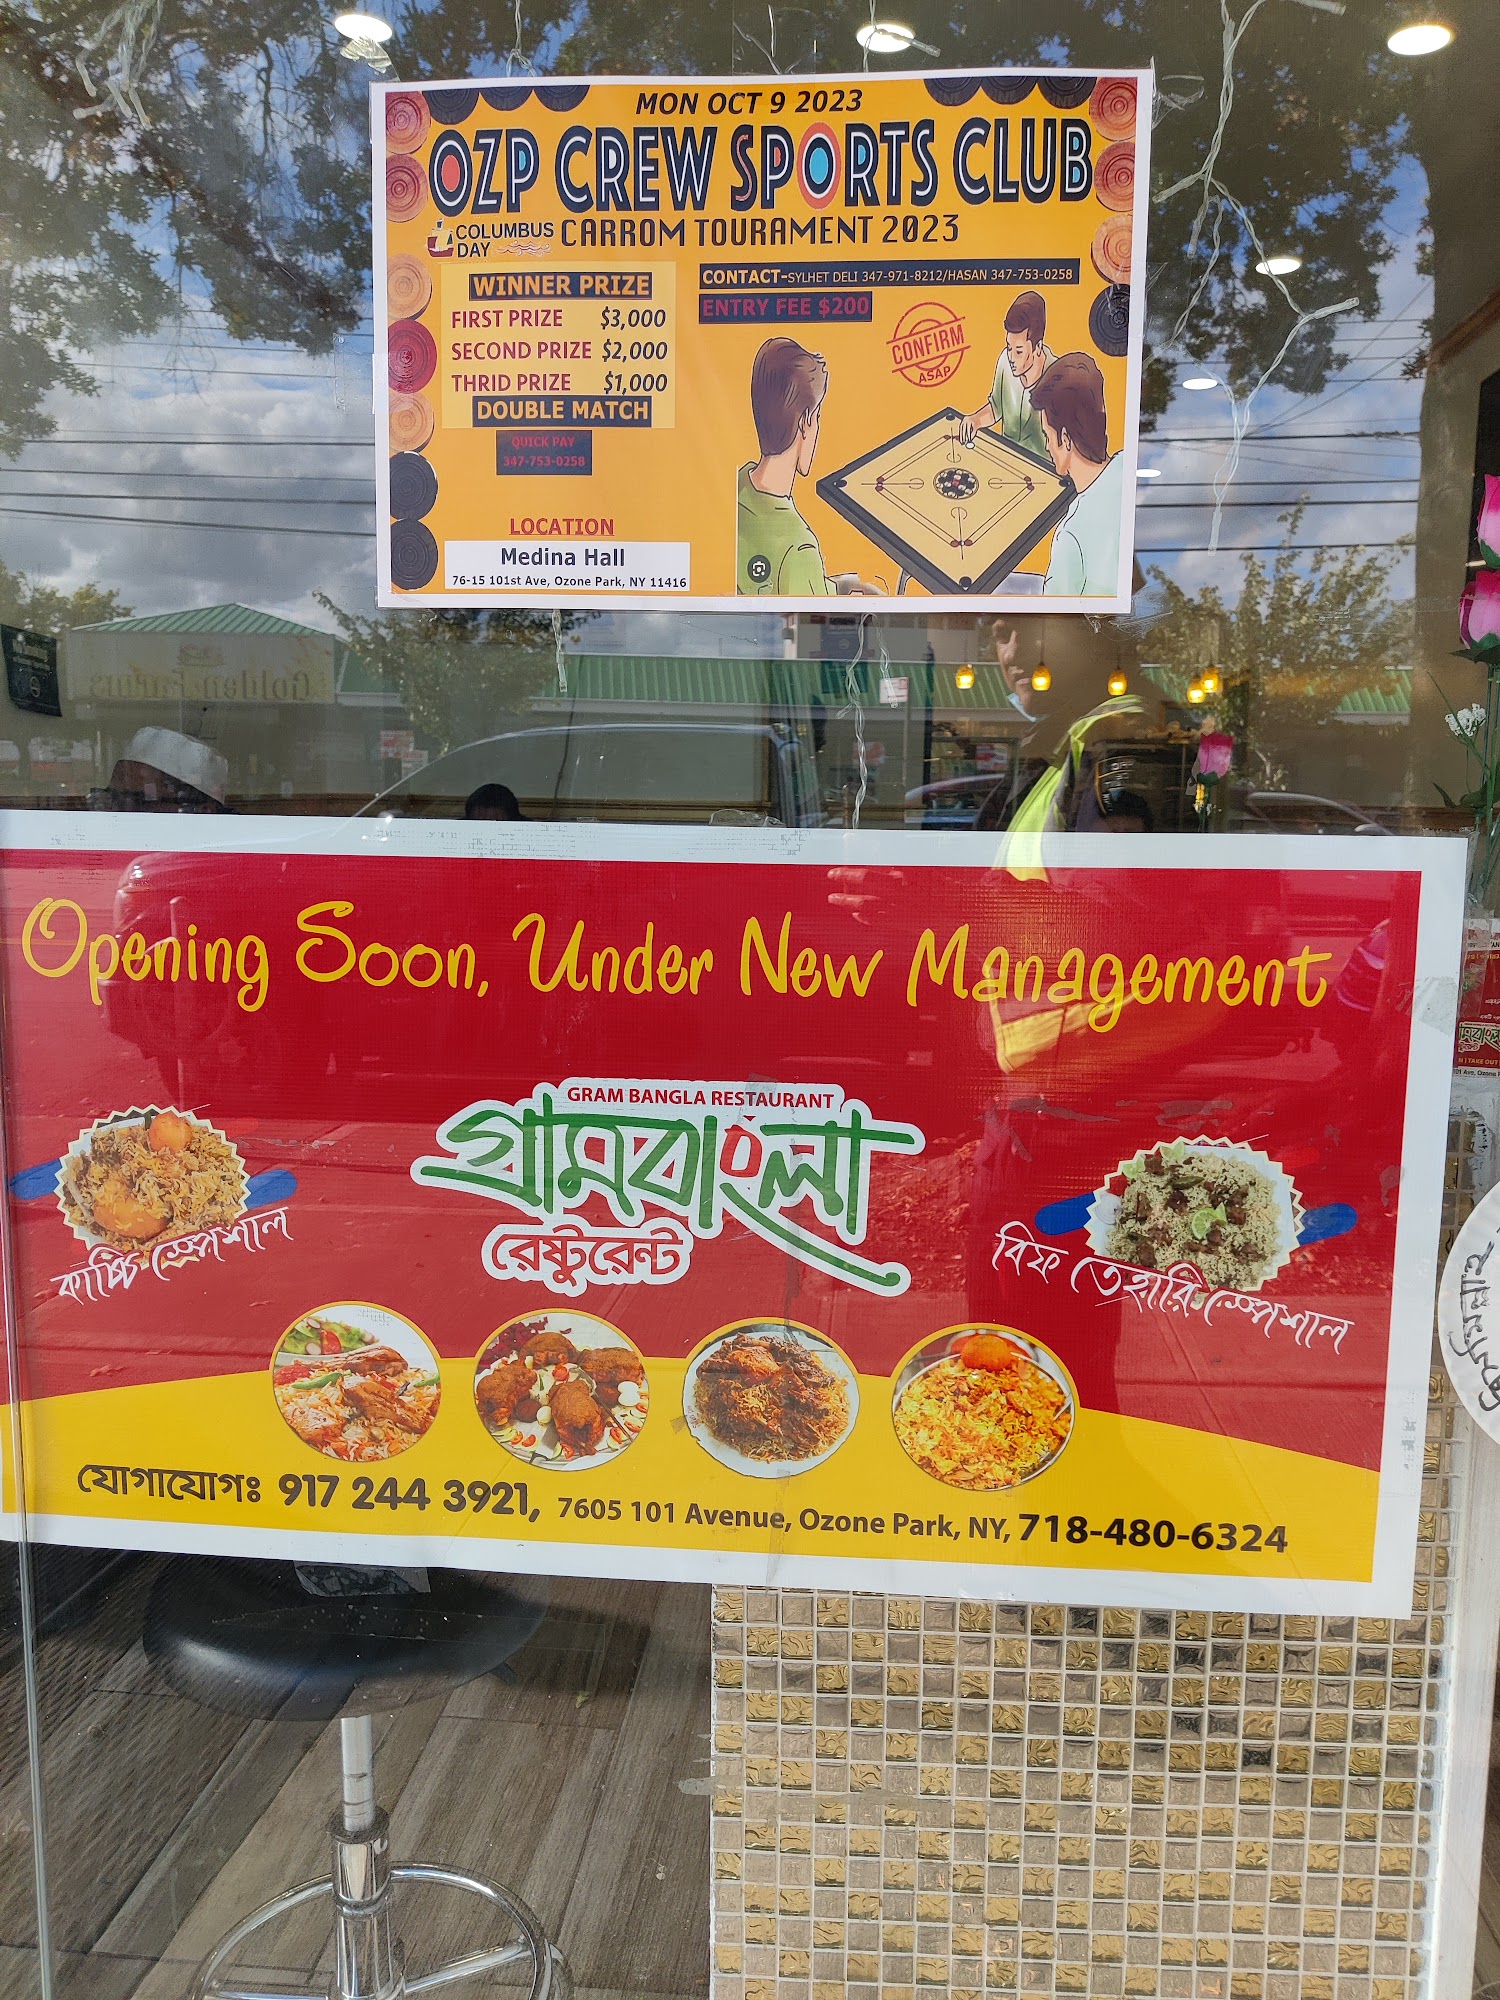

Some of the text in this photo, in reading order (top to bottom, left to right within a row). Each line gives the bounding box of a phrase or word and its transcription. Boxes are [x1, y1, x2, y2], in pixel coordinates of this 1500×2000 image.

[636, 89, 863, 115] MON OCT 9 2023
[428, 117, 1093, 217] OZP CREW SPORTS CLUB
[456, 222, 554, 240] COLUMBUS
[561, 214, 959, 247] CARROM TOURAMENT 2023
[457, 241, 490, 258] DAY
[473, 273, 650, 297] WINNER PRIZE
[833, 271, 858, 284] DELI
[861, 269, 987, 283] 347-971-8212/HASAN
[991, 268, 1073, 281] 347-753-0258
[451, 306, 667, 330] FIRST PRIZE $3,000
[703, 295, 869, 317] ENTRY FEE $200
[451, 338, 668, 363] SECOND PRIZE $2,000
[892, 324, 964, 364] CONFIRM
[451, 371, 668, 395] THRID PRIZE $1,000
[918, 366, 951, 383] ASAP
[477, 400, 649, 420] DOUBLE MATCH
[512, 436, 575, 449] QUICK PAY
[503, 455, 586, 468] 347-753-0258
[509, 518, 615, 537] LOCATION
[501, 547, 625, 567] Medina Hall
[452, 575, 686, 589] 76-15 101st Ave, Ozone Park, NY 11416
[22, 897, 1332, 1032] Opening Soon, Under New Management
[567, 1087, 835, 1109] GRAM BANGLA RESTAURANT
[420, 1093, 916, 1287] গ্রামবাংলা
[992, 1220, 1069, 1284] বিফ
[278, 1473, 340, 1507] 917
[351, 1476, 431, 1511] 244
[442, 1479, 541, 1523] 3921,
[557, 1497, 1288, 1553] 7605 101 Avenue, Ozone Park, NY, 718-480-6324
